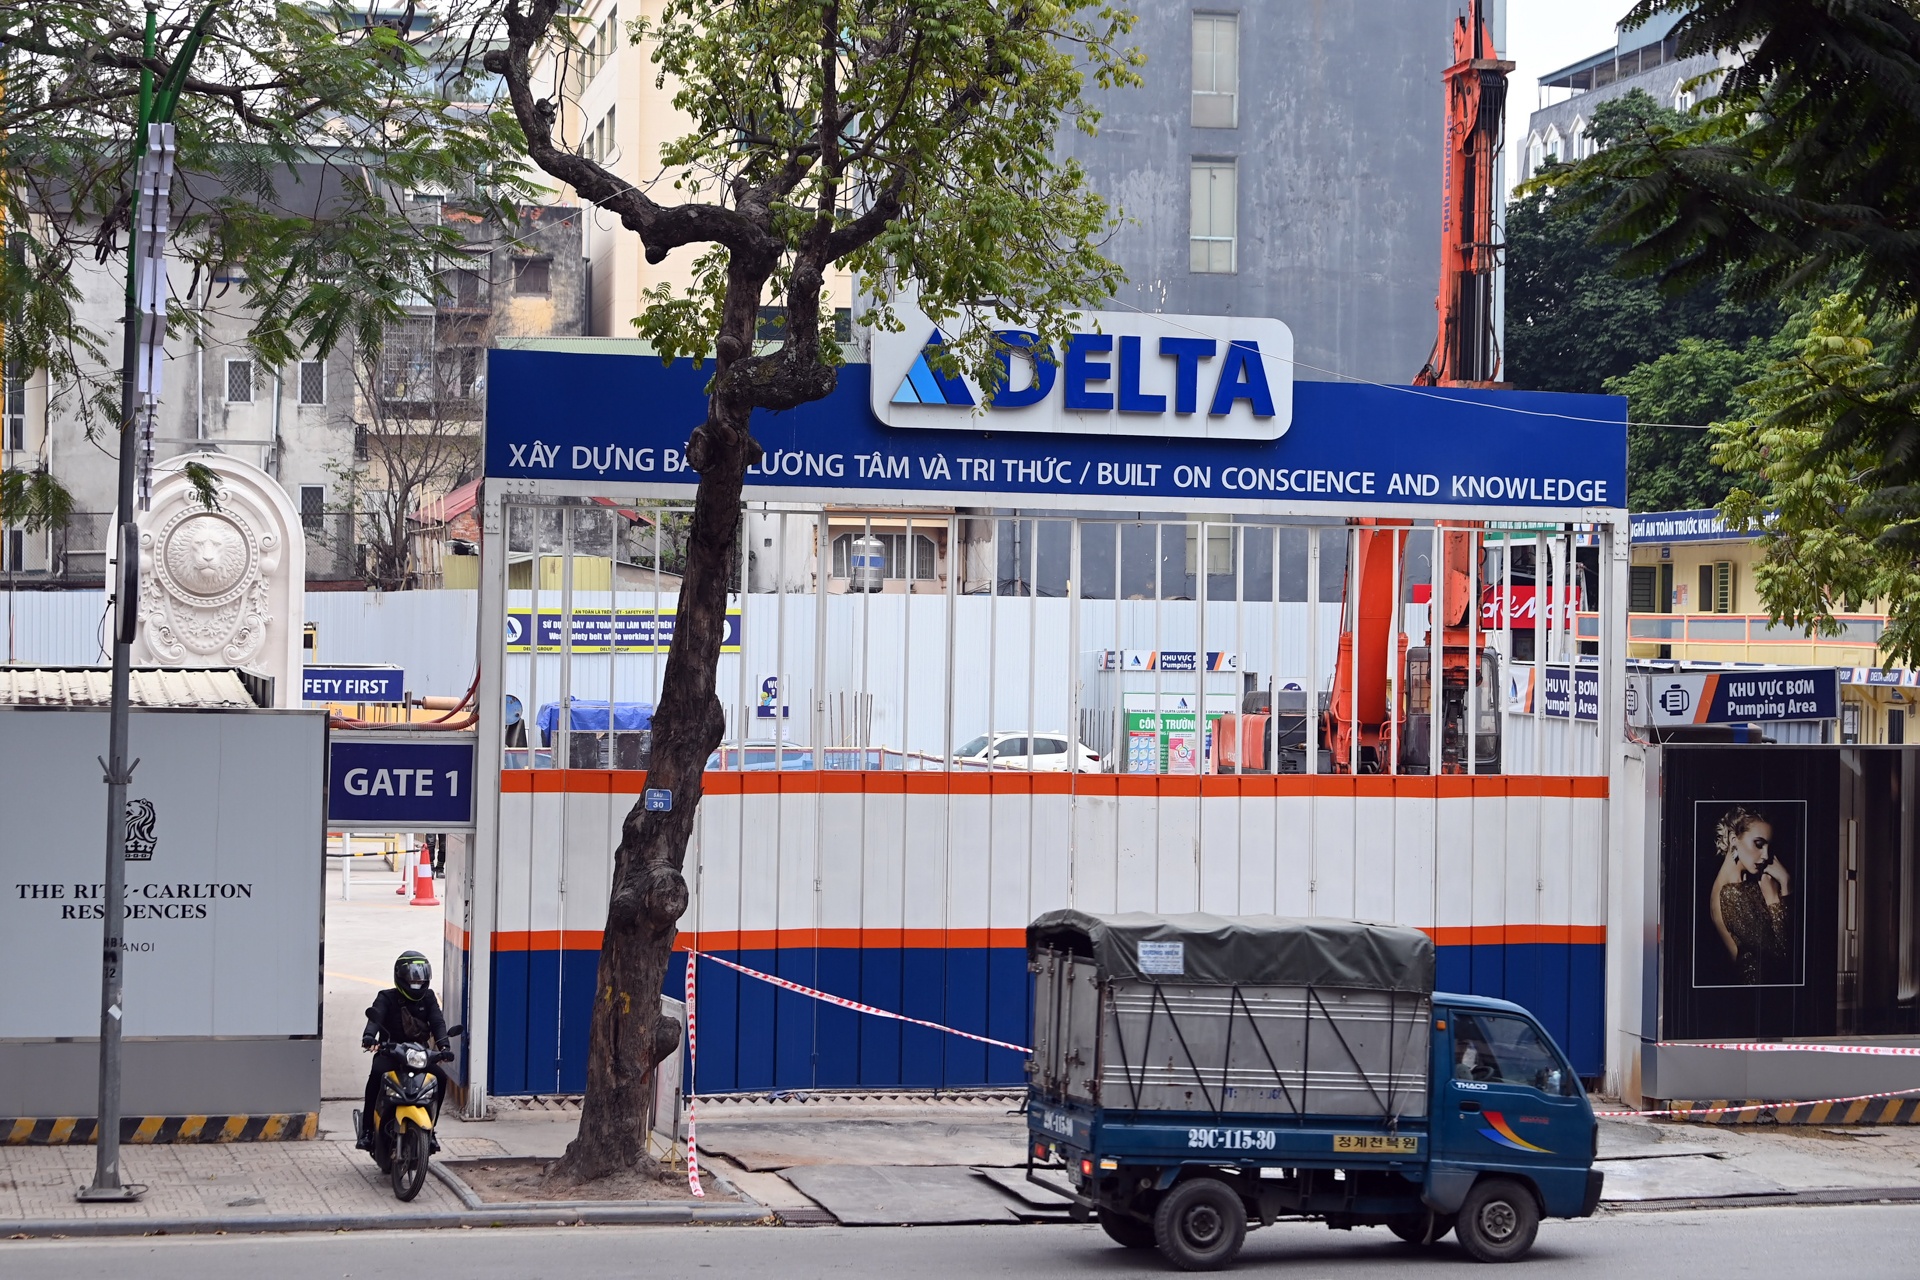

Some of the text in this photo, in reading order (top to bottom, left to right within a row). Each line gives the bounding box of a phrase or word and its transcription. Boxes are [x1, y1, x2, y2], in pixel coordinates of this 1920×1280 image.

[989, 329, 1276, 416] DELTA
[508, 440, 561, 468] XÂY
[572, 443, 654, 475] DỰNG
[854, 451, 910, 479] TÂM
[919, 453, 951, 480] VÀ
[956, 457, 995, 481] TRI
[1002, 456, 1072, 484] THỨC
[1079, 461, 1091, 485] /
[1098, 462, 1162, 487] BUILT
[1173, 465, 1211, 488] ON
[1221, 467, 1375, 494] CONSCIENCE
[1387, 473, 1440, 497] AND
[1452, 475, 1607, 502] KNOWLEDGE
[1646, 522, 1655, 537] AN
[1656, 518, 1674, 536] TOÀN
[1698, 518, 1710, 534] KHI
[1162, 661, 1192, 670] Pumping
[345, 679, 389, 694] FIRST
[1578, 680, 1598, 696] BƠM
[1729, 679, 1815, 700] KHU VỰC BƠM
[1578, 699, 1597, 714] Area
[1727, 699, 1817, 719] Pumping Area
[343, 768, 459, 797] GATE 1
[652, 801, 664, 809] 30
[15, 884, 65, 899] THE
[61, 903, 208, 919] RESDENCES
[121, 942, 156, 953] ANOI
[1455, 1082, 1488, 1091] THACO
